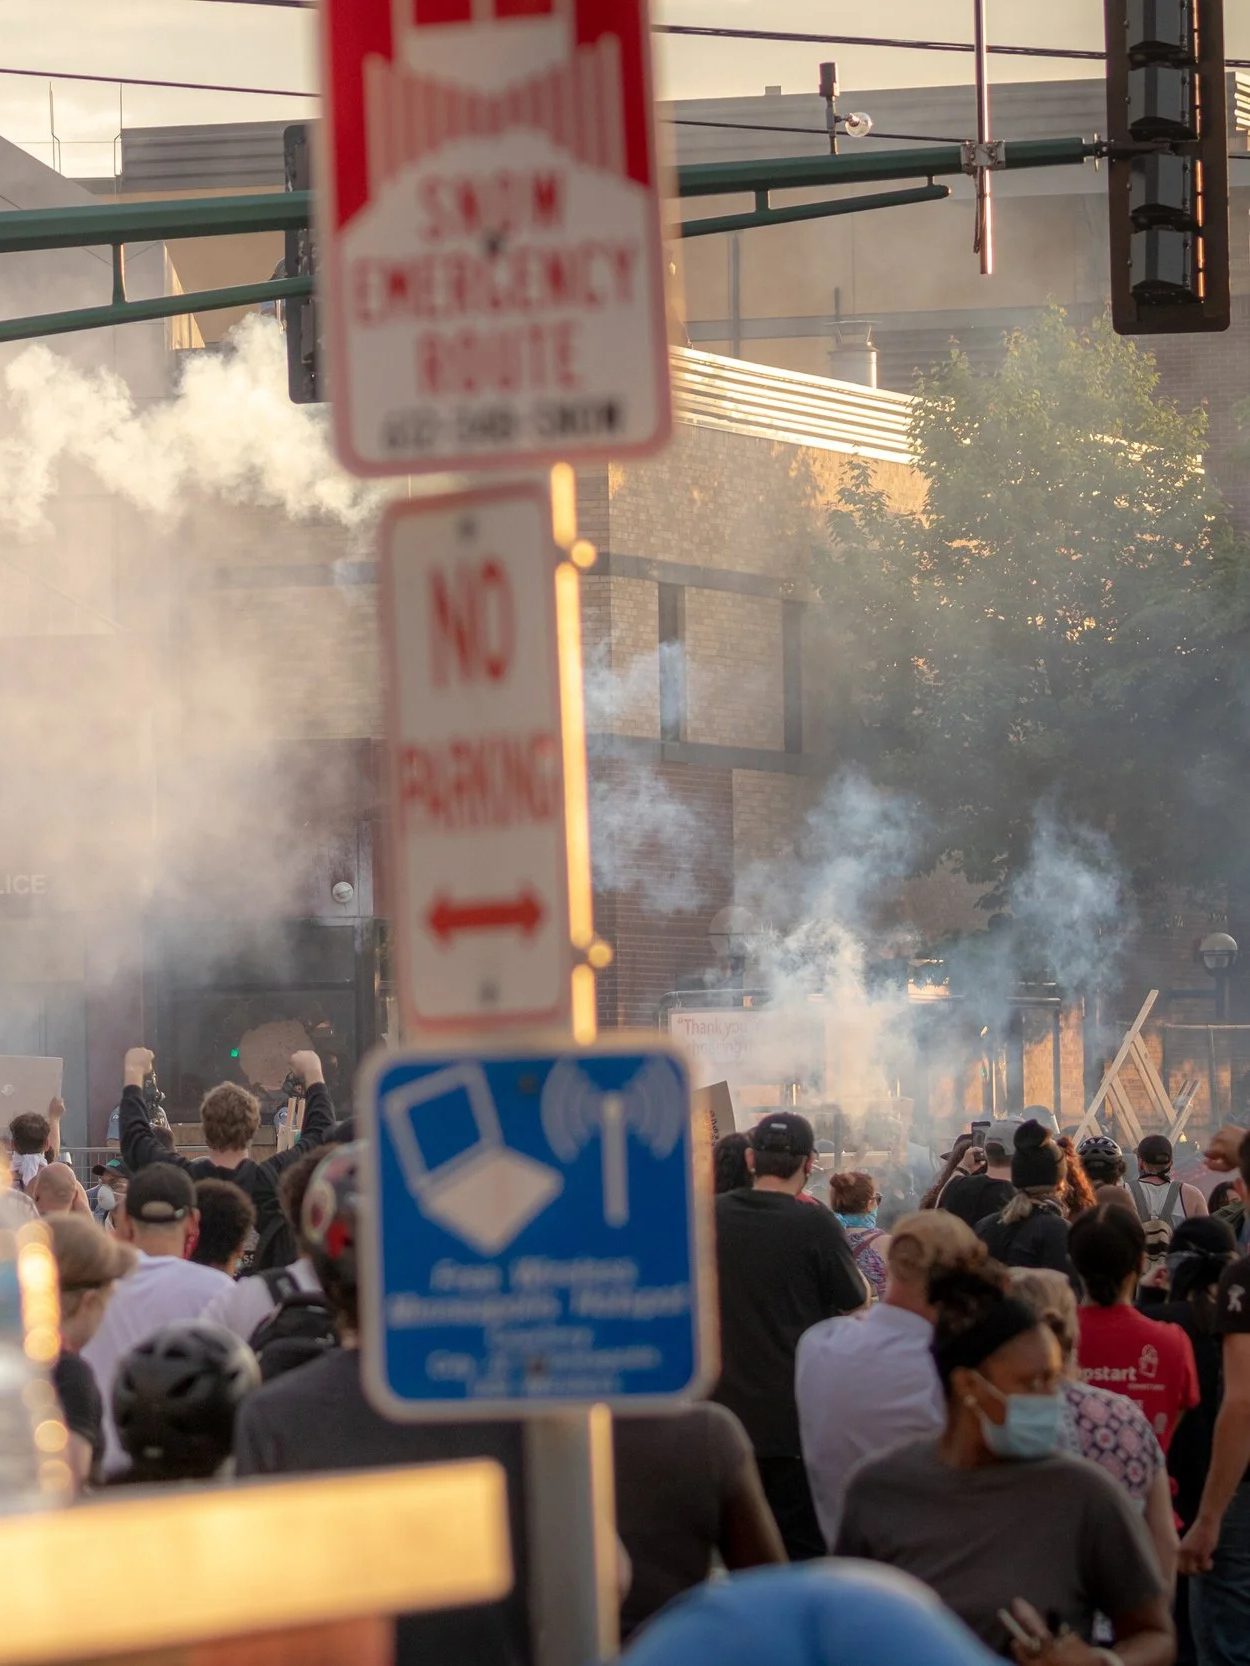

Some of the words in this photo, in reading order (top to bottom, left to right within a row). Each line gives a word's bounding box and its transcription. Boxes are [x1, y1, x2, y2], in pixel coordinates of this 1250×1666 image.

[419, 167, 567, 244] SNOW
[354, 241, 637, 331] EMERGENCY
[417, 319, 580, 397] ROUTE
[427, 556, 516, 690] NO
[396, 733, 562, 838] PARKING
[724, 1021, 748, 1041] you
